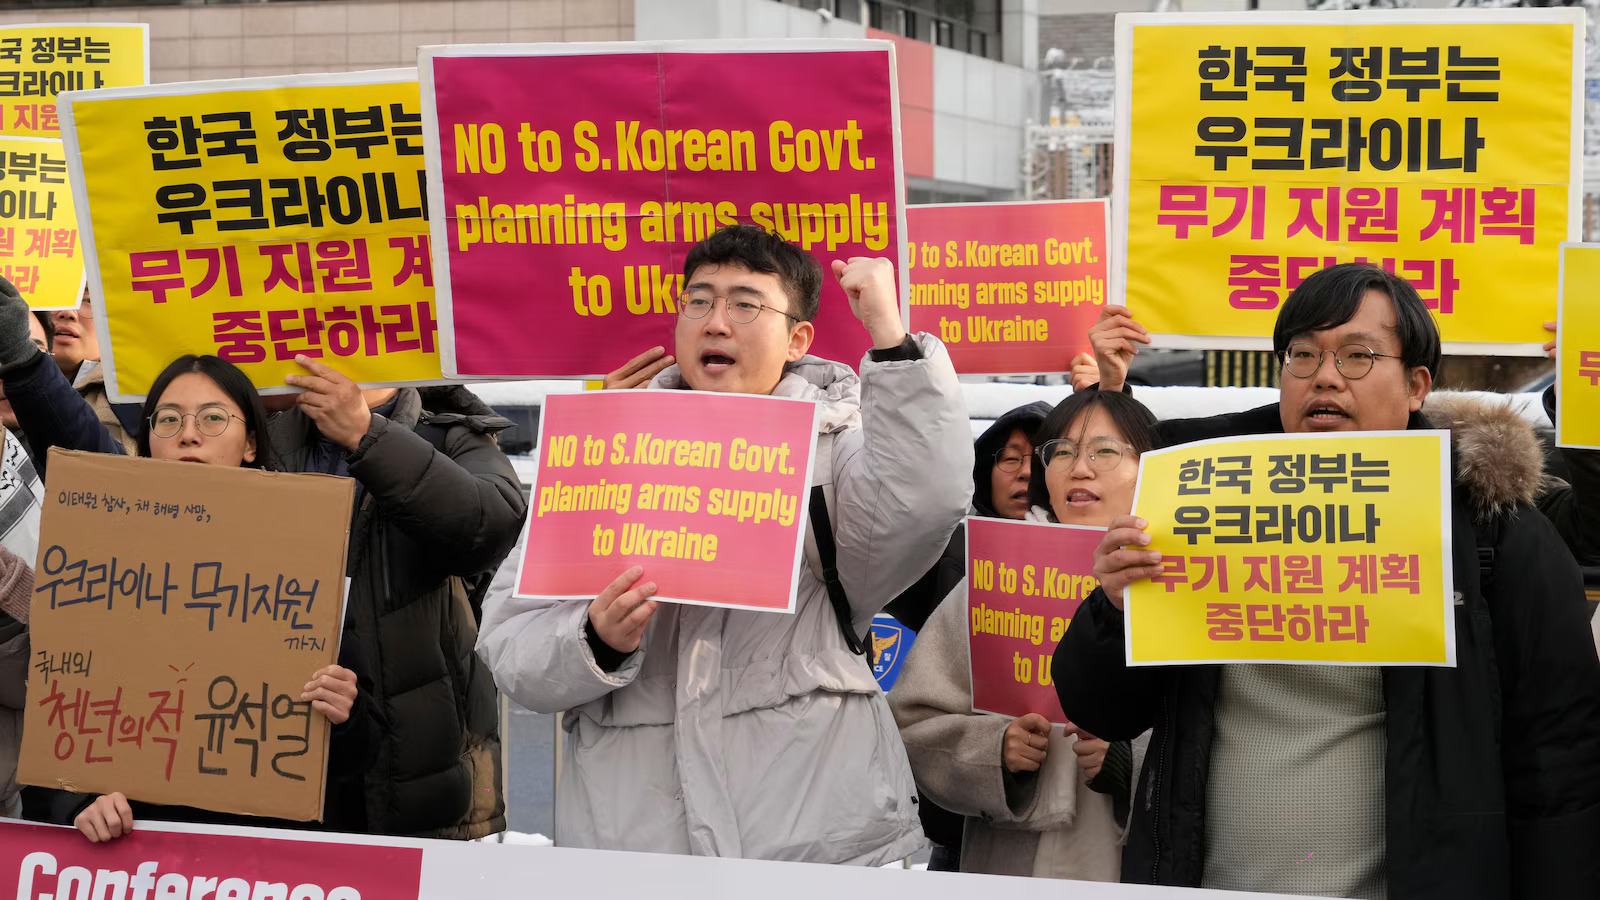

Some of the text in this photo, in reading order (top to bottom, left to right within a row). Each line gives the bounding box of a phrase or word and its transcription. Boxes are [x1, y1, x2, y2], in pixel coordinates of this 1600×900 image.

[31, 36, 110, 64] 정부는
[1198, 45, 1501, 102] 한국 정부는
[143, 111, 258, 171] 한국
[454, 122, 506, 174] NO
[518, 121, 562, 172] to
[768, 119, 876, 173] Govt.
[1194, 116, 1486, 172] 우크라이나
[0, 151, 66, 184] 부는
[456, 193, 888, 251] planning arms supply
[1157, 185, 1536, 244] 무기 지원 계획
[24, 228, 77, 258] 계획
[921, 242, 940, 268] to
[1045, 236, 1098, 265] Govt.
[129, 245, 243, 304] 무기
[259, 238, 373, 294] 지원
[568, 266, 612, 316] to
[976, 280, 1028, 305] arms
[1034, 275, 1104, 306] supply
[1228, 254, 1460, 314] 중라
[213, 302, 438, 364] 중단하라
[939, 315, 1049, 343] to Ukraine
[547, 435, 577, 468] NO
[584, 434, 605, 466] to
[728, 437, 795, 475] Govt.
[1177, 452, 1390, 495] 한국 정부는
[58, 491, 211, 523] 이태원 참사, 채 해병 사망,
[537, 478, 797, 527] planning arms supply
[593, 522, 718, 562] to Ukraine
[1173, 503, 1380, 545] 우크라이나
[35, 545, 178, 615] 우크라이나
[973, 559, 1101, 600] NO to S.Kore
[1150, 553, 1420, 595] 무기 지원 계획
[284, 634, 326, 652] 까지
[971, 602, 1044, 645] planning
[1205, 602, 1370, 644] 중단하라
[34, 650, 93, 684] 국내외
[1013, 651, 1032, 683] to
[194, 675, 313, 782] 윤석열
